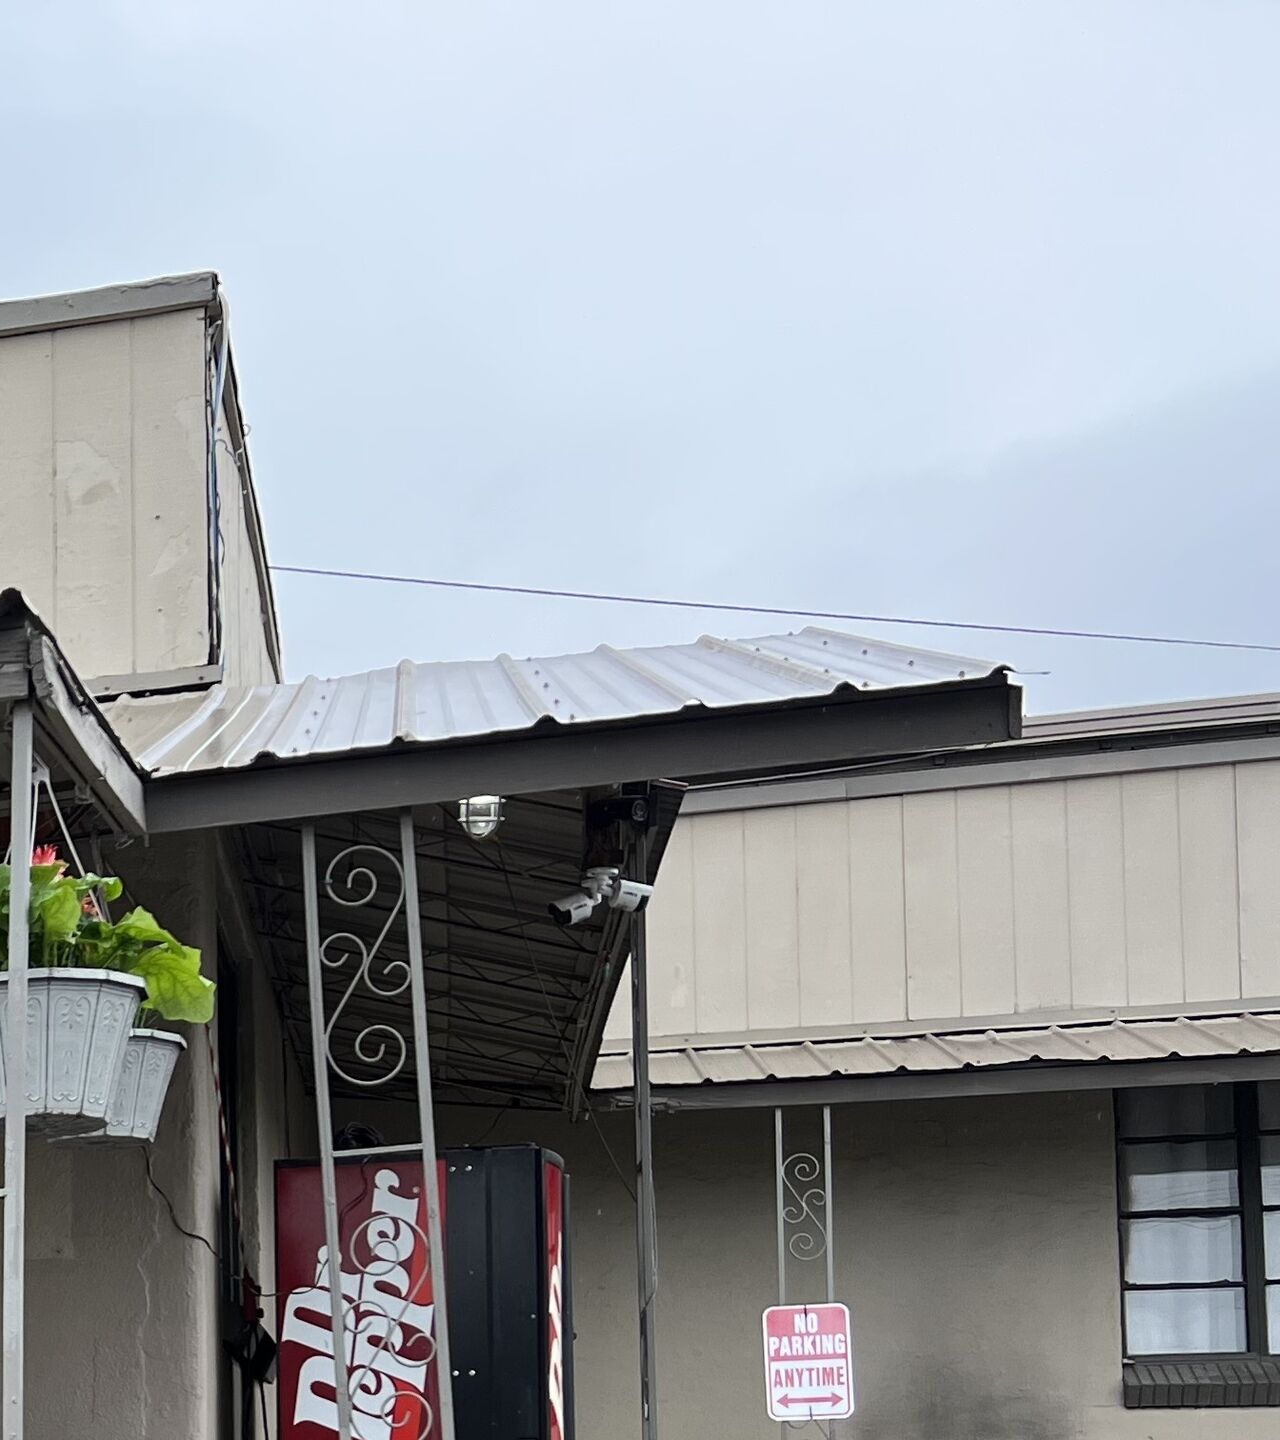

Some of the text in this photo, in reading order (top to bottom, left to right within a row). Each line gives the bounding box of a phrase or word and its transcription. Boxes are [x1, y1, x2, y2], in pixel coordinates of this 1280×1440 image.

[281, 1245, 363, 1368] Dr
[793, 1312, 819, 1334] NO
[768, 1333, 846, 1357] PARKING
[773, 1366, 845, 1388] ANYTIME
